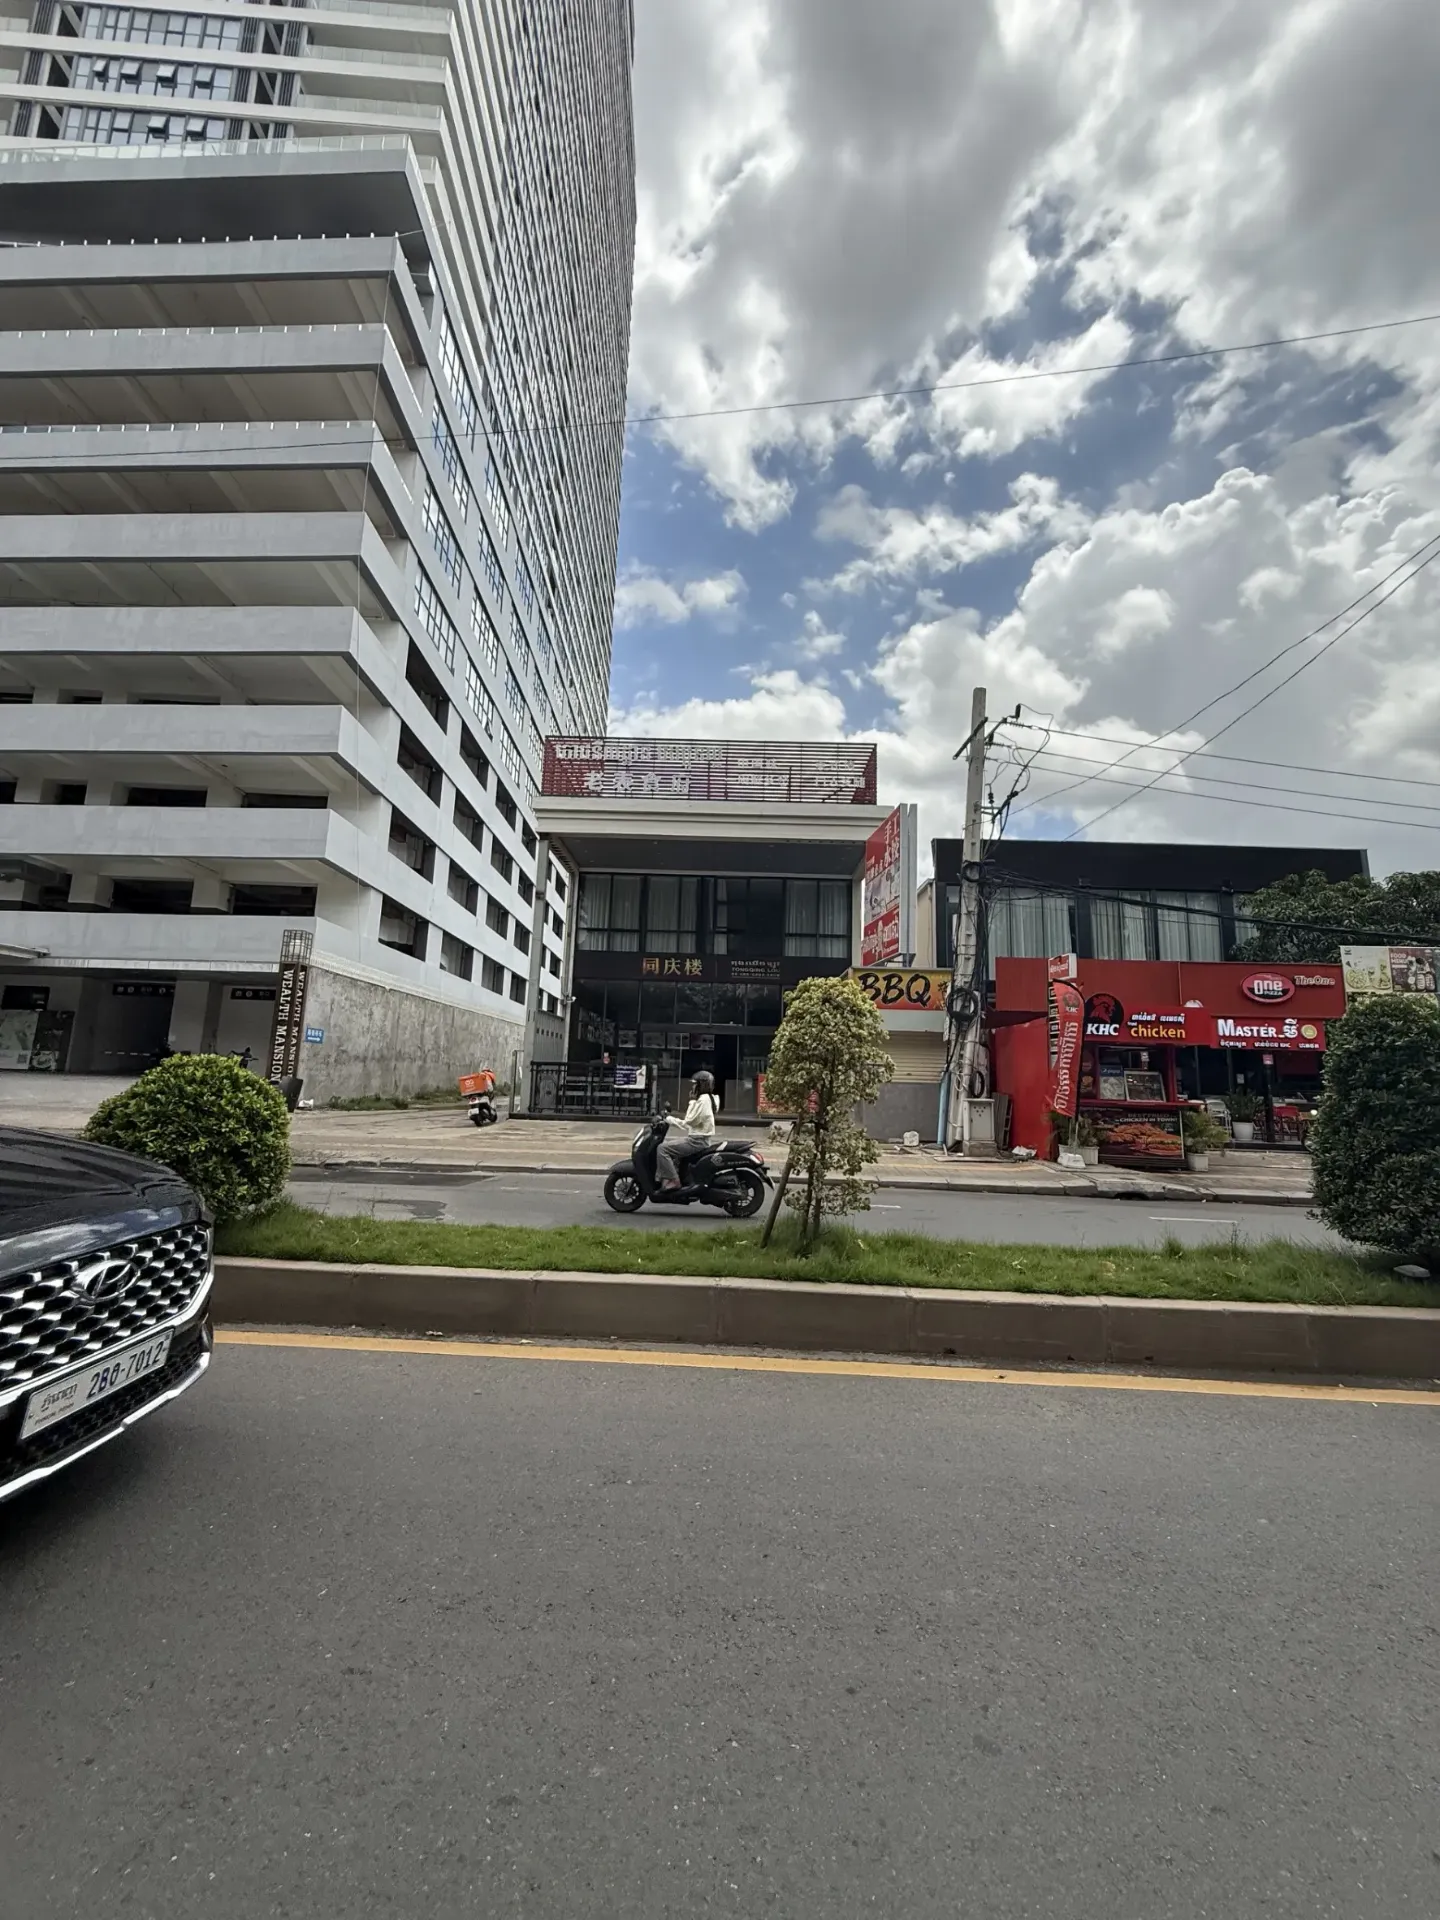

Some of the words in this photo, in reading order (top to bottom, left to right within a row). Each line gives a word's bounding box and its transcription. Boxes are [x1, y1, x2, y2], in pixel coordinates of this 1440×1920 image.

[642, 957, 703, 976] 同庆楼
[278, 969, 295, 1021] WEALTH
[294, 971, 305, 1022] WEALTH
[858, 972, 931, 1007] BBQ
[1086, 1023, 1119, 1036] KHC
[1130, 1024, 1186, 1038] chicken
[270, 1024, 288, 1087] MANSION
